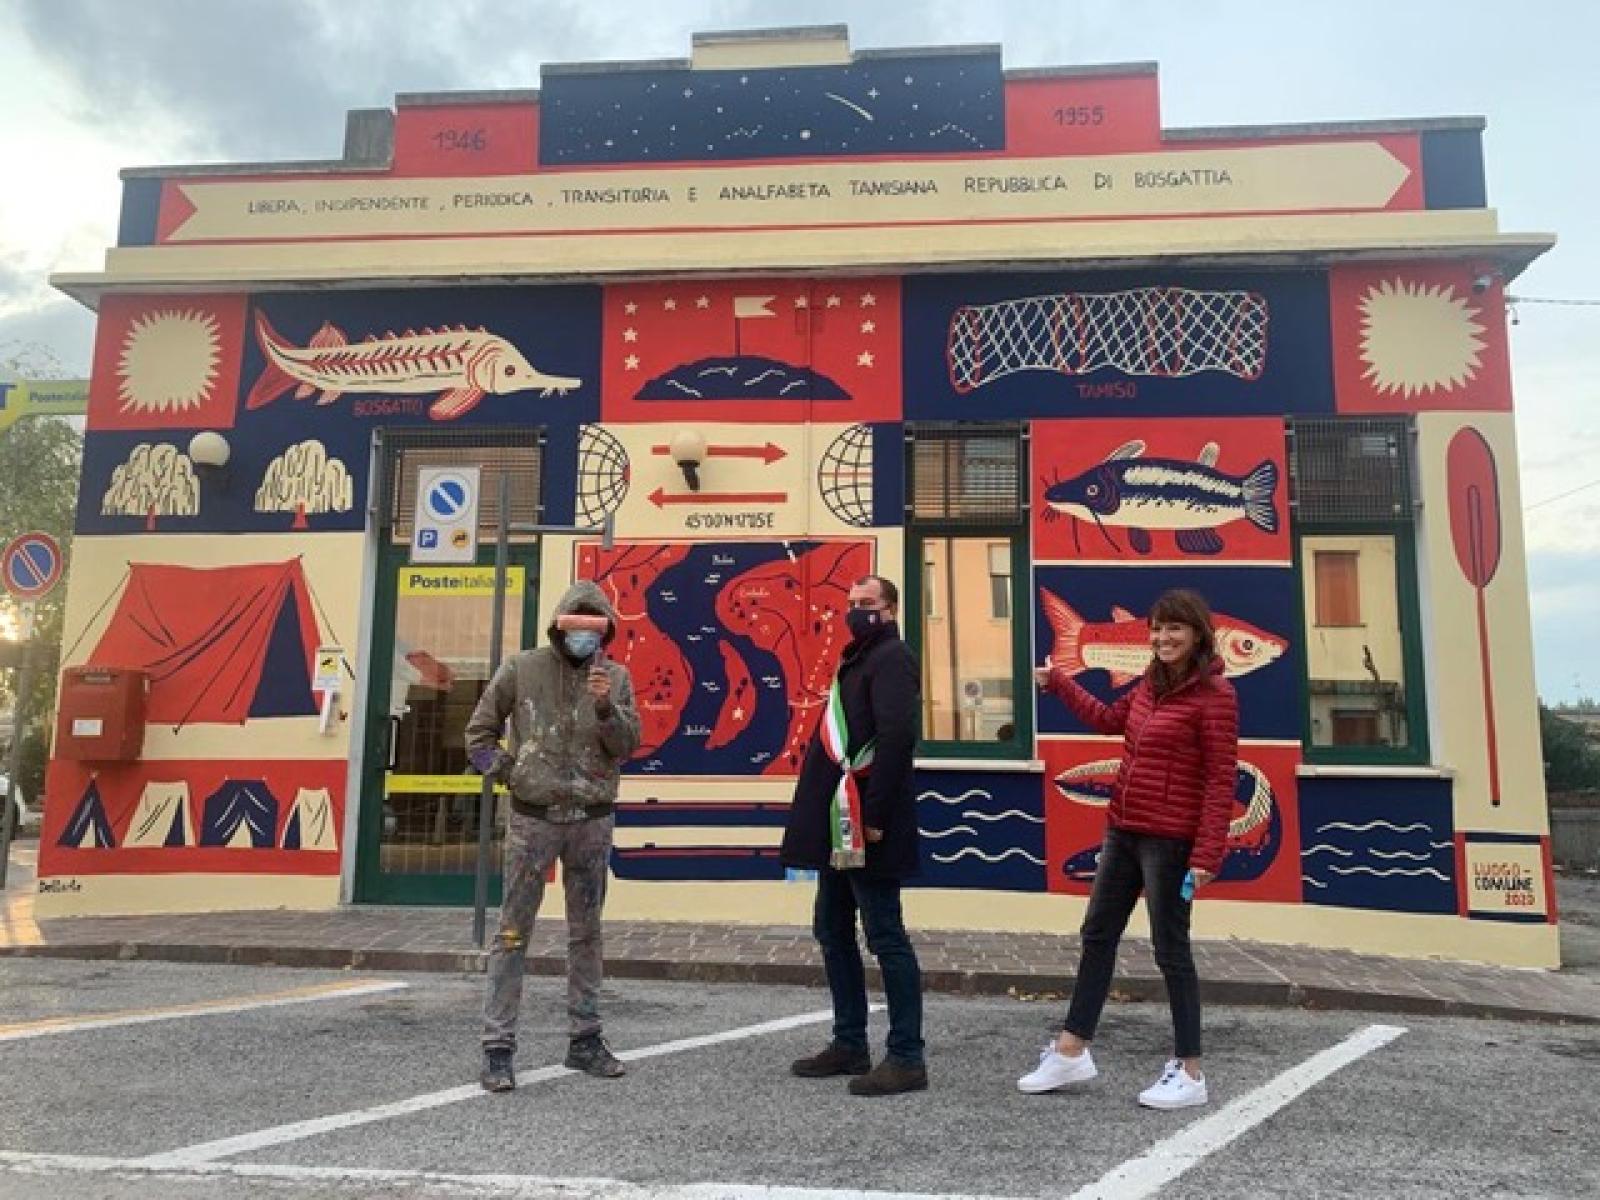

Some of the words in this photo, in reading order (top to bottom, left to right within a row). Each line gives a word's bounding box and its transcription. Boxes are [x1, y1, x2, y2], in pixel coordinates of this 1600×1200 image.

[1055, 106, 1105, 126] 1955
[432, 129, 487, 151] 1946
[453, 192, 533, 208] PERIODICA
[561, 187, 670, 204] TRANSITORIA
[687, 187, 697, 203] E
[719, 183, 831, 200] ANALFABETA
[849, 179, 938, 196] TAMISIANA
[964, 175, 1068, 193] REPUBBLICA
[1094, 171, 1113, 190] DI
[1134, 169, 1232, 188] BOSGATTIA
[1075, 382, 1137, 398] TAMISO
[409, 573, 514, 589] Posteitaliae
